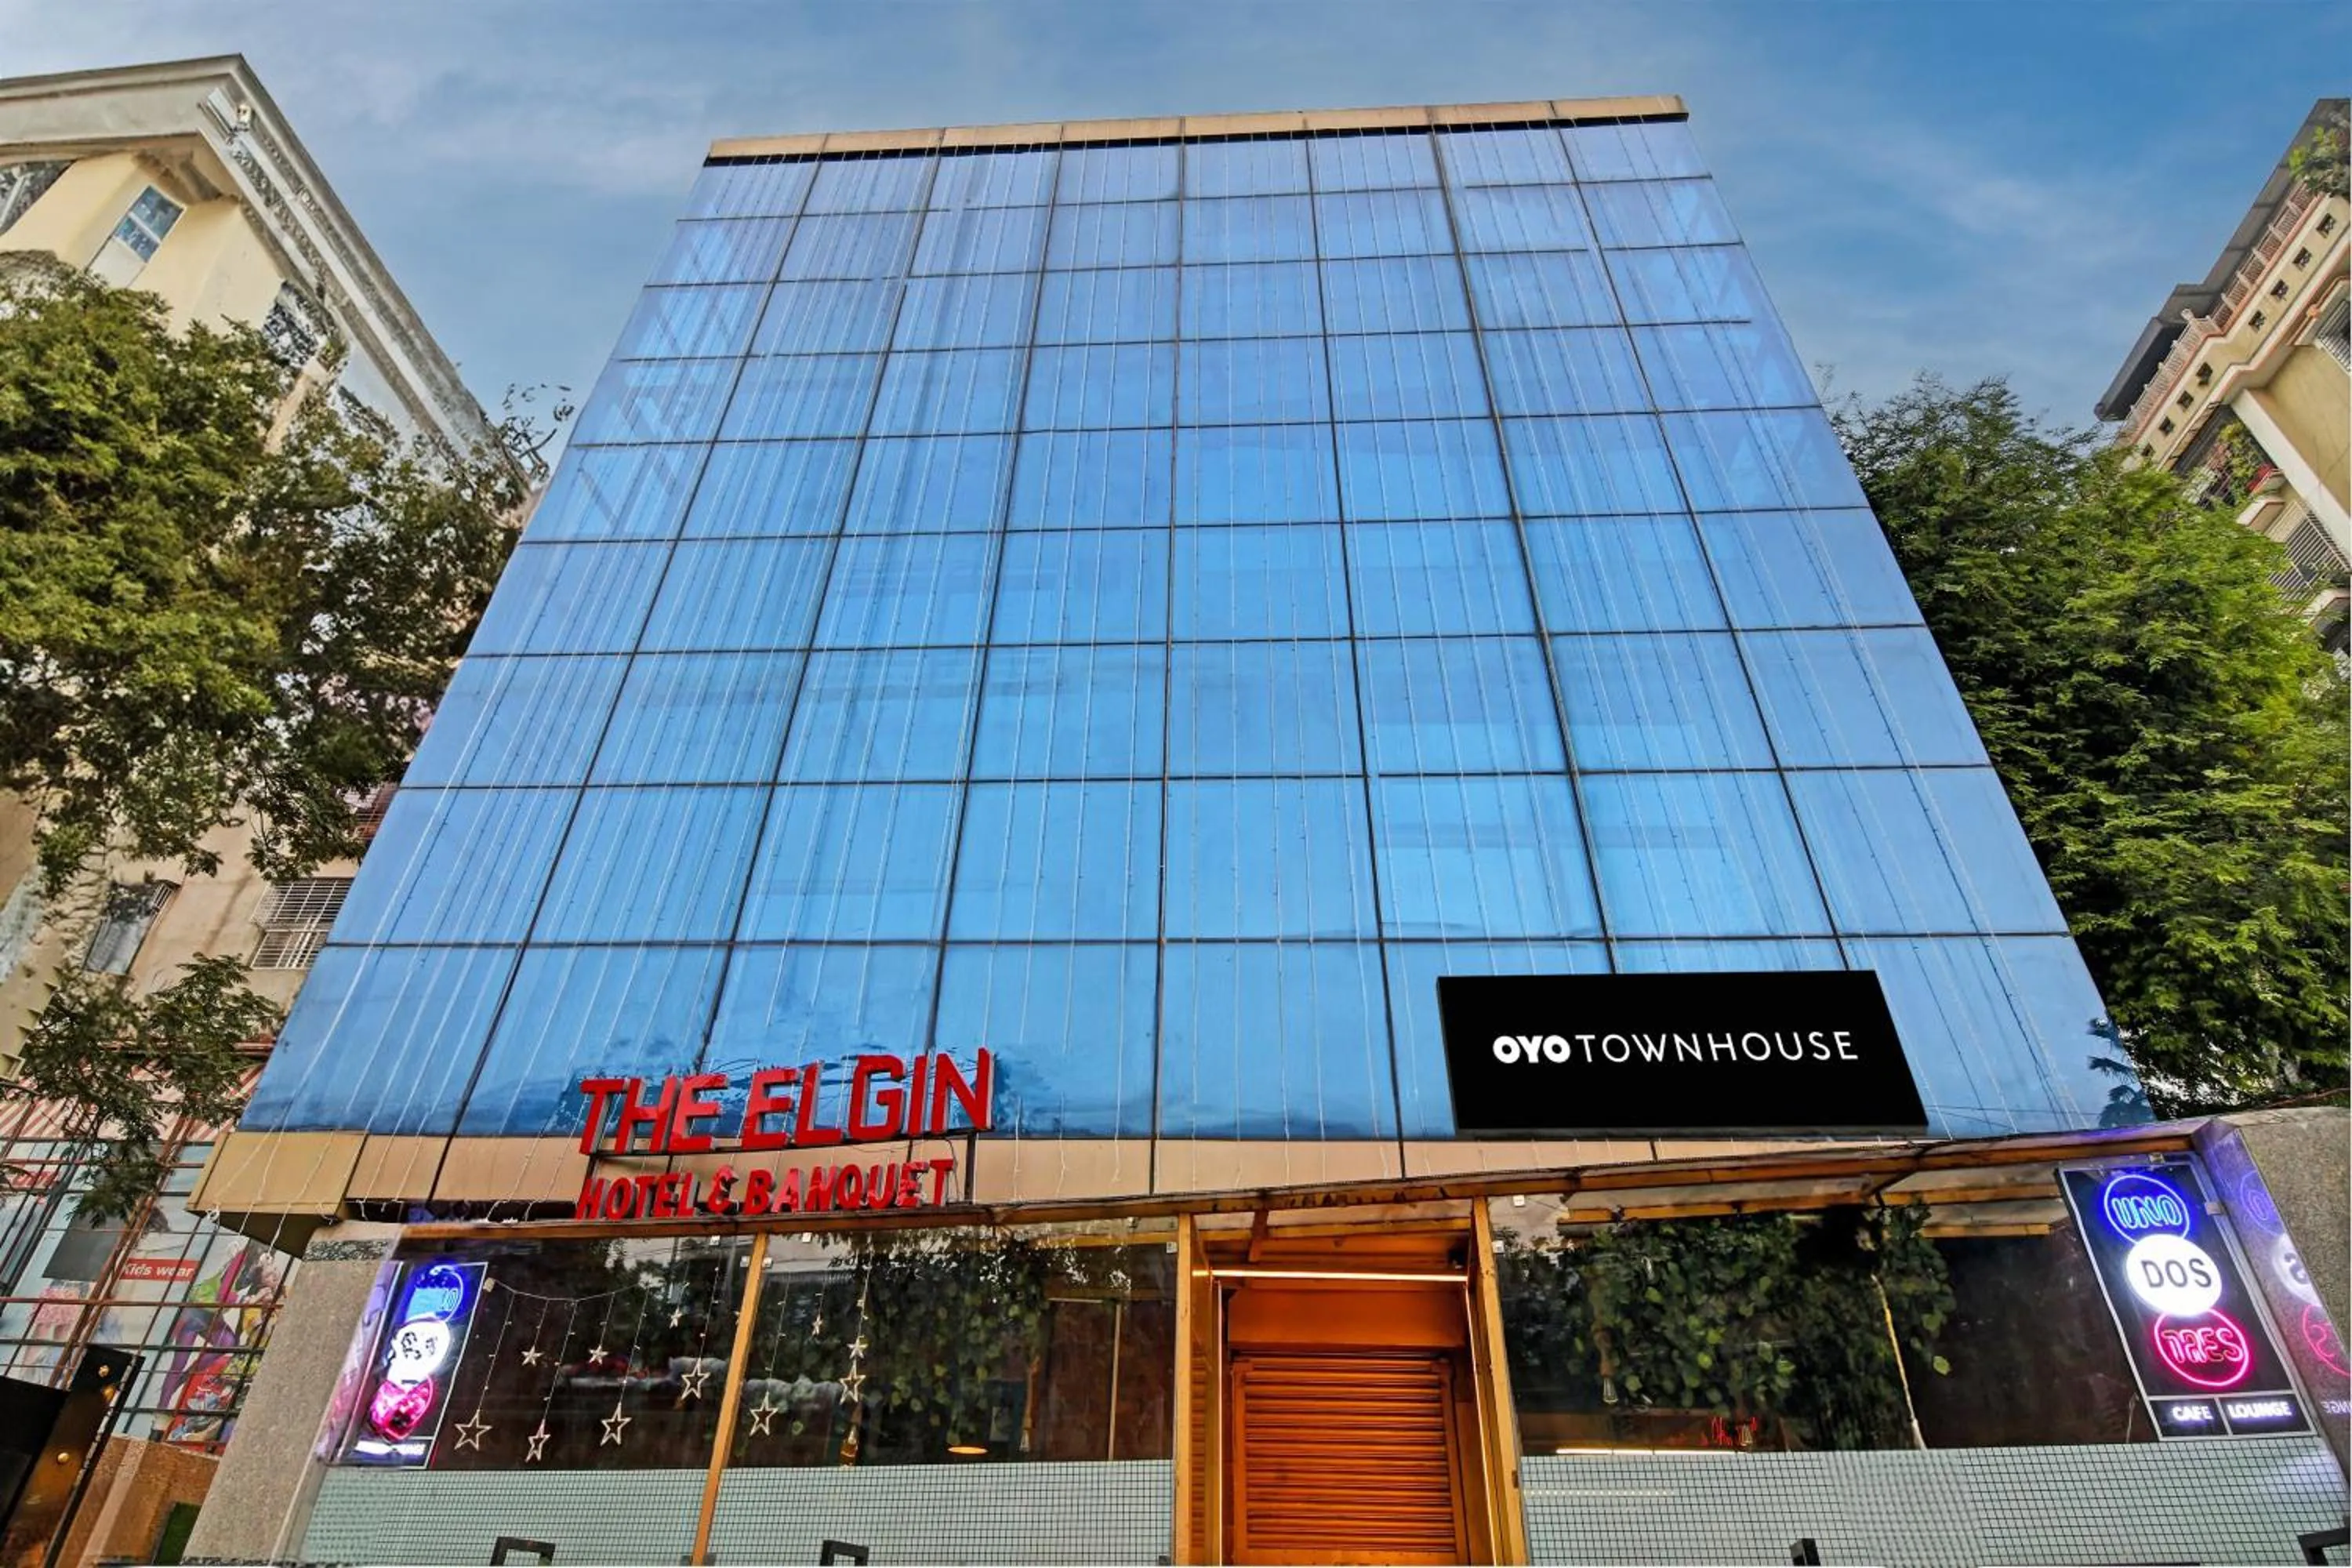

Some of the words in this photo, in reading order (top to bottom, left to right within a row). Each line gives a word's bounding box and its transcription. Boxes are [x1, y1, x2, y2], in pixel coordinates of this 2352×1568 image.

[1493, 1035, 1570, 1064] OYO
[1575, 1031, 1858, 1062] TOWNHOUSE
[579, 1073, 728, 1155] THE
[741, 1047, 993, 1150] ELGIN
[575, 1170, 699, 1220] HOTEL
[708, 1166, 737, 1214] &
[743, 1159, 954, 1215] BANQUET
[2113, 1195, 2182, 1229] UNO
[2141, 1258, 2212, 1287] DOS
[2161, 1327, 2243, 1363] TRES
[2172, 1403, 2213, 1421] CAFE
[2228, 1400, 2292, 1419] LOUNGE
